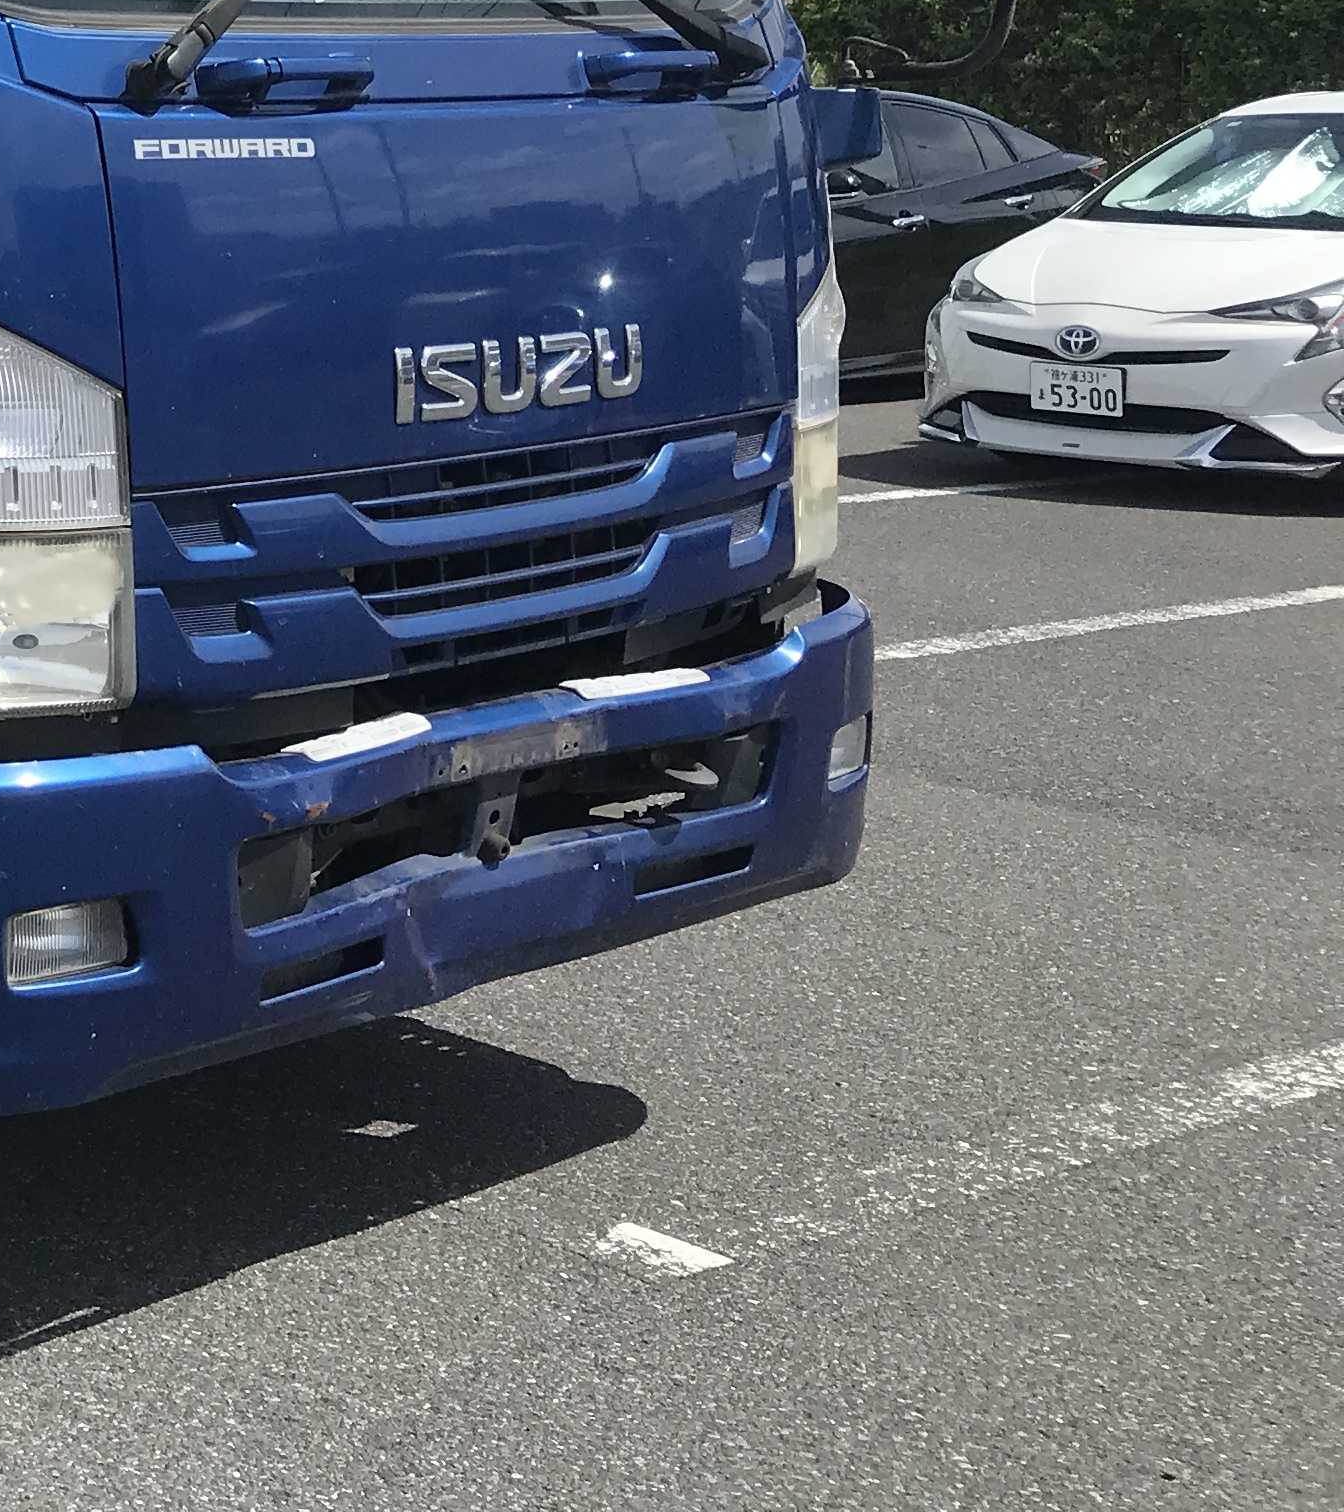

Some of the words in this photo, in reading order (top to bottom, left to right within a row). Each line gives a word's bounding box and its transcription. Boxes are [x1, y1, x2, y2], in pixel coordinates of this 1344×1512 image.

[133, 137, 316, 160] FORWARD
[394, 323, 643, 425] ISUZU
[1050, 383, 1117, 412] 53-00
